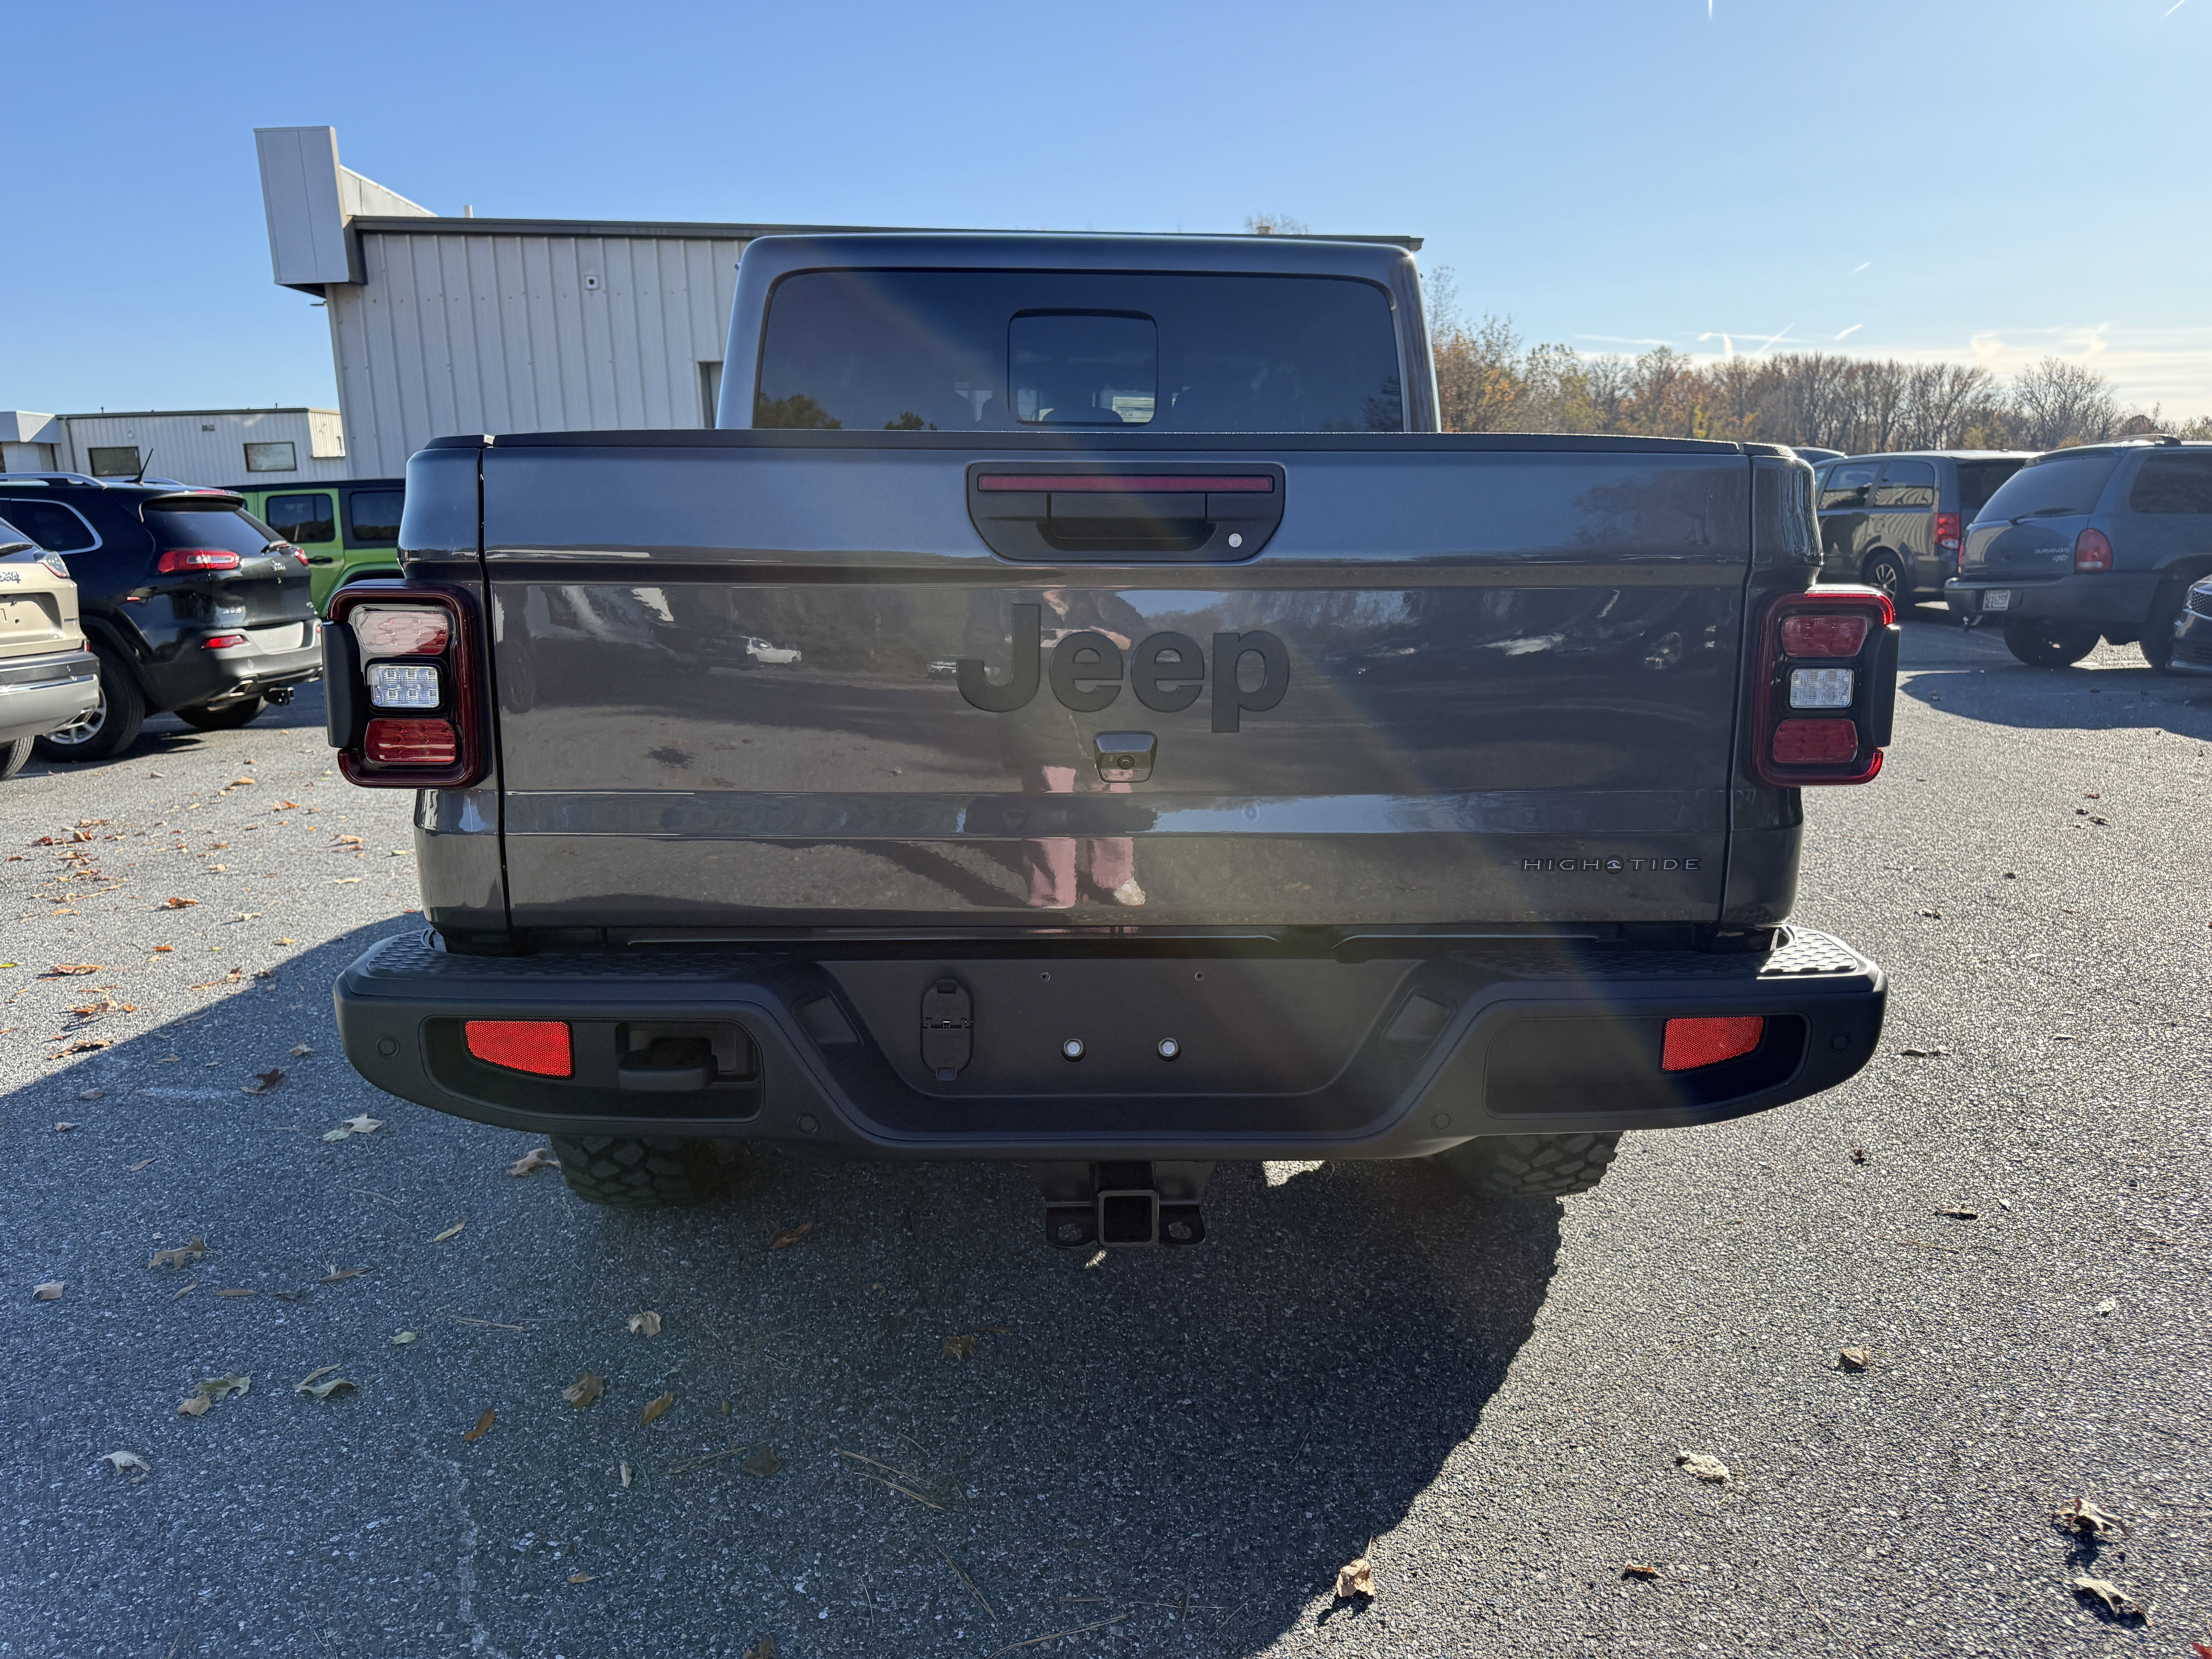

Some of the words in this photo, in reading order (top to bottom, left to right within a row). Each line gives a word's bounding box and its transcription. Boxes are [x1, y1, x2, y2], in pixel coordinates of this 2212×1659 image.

[956, 603, 1290, 733] Jeep
[1522, 859, 1601, 871] HIGH
[1627, 858, 1701, 870] TIDE
